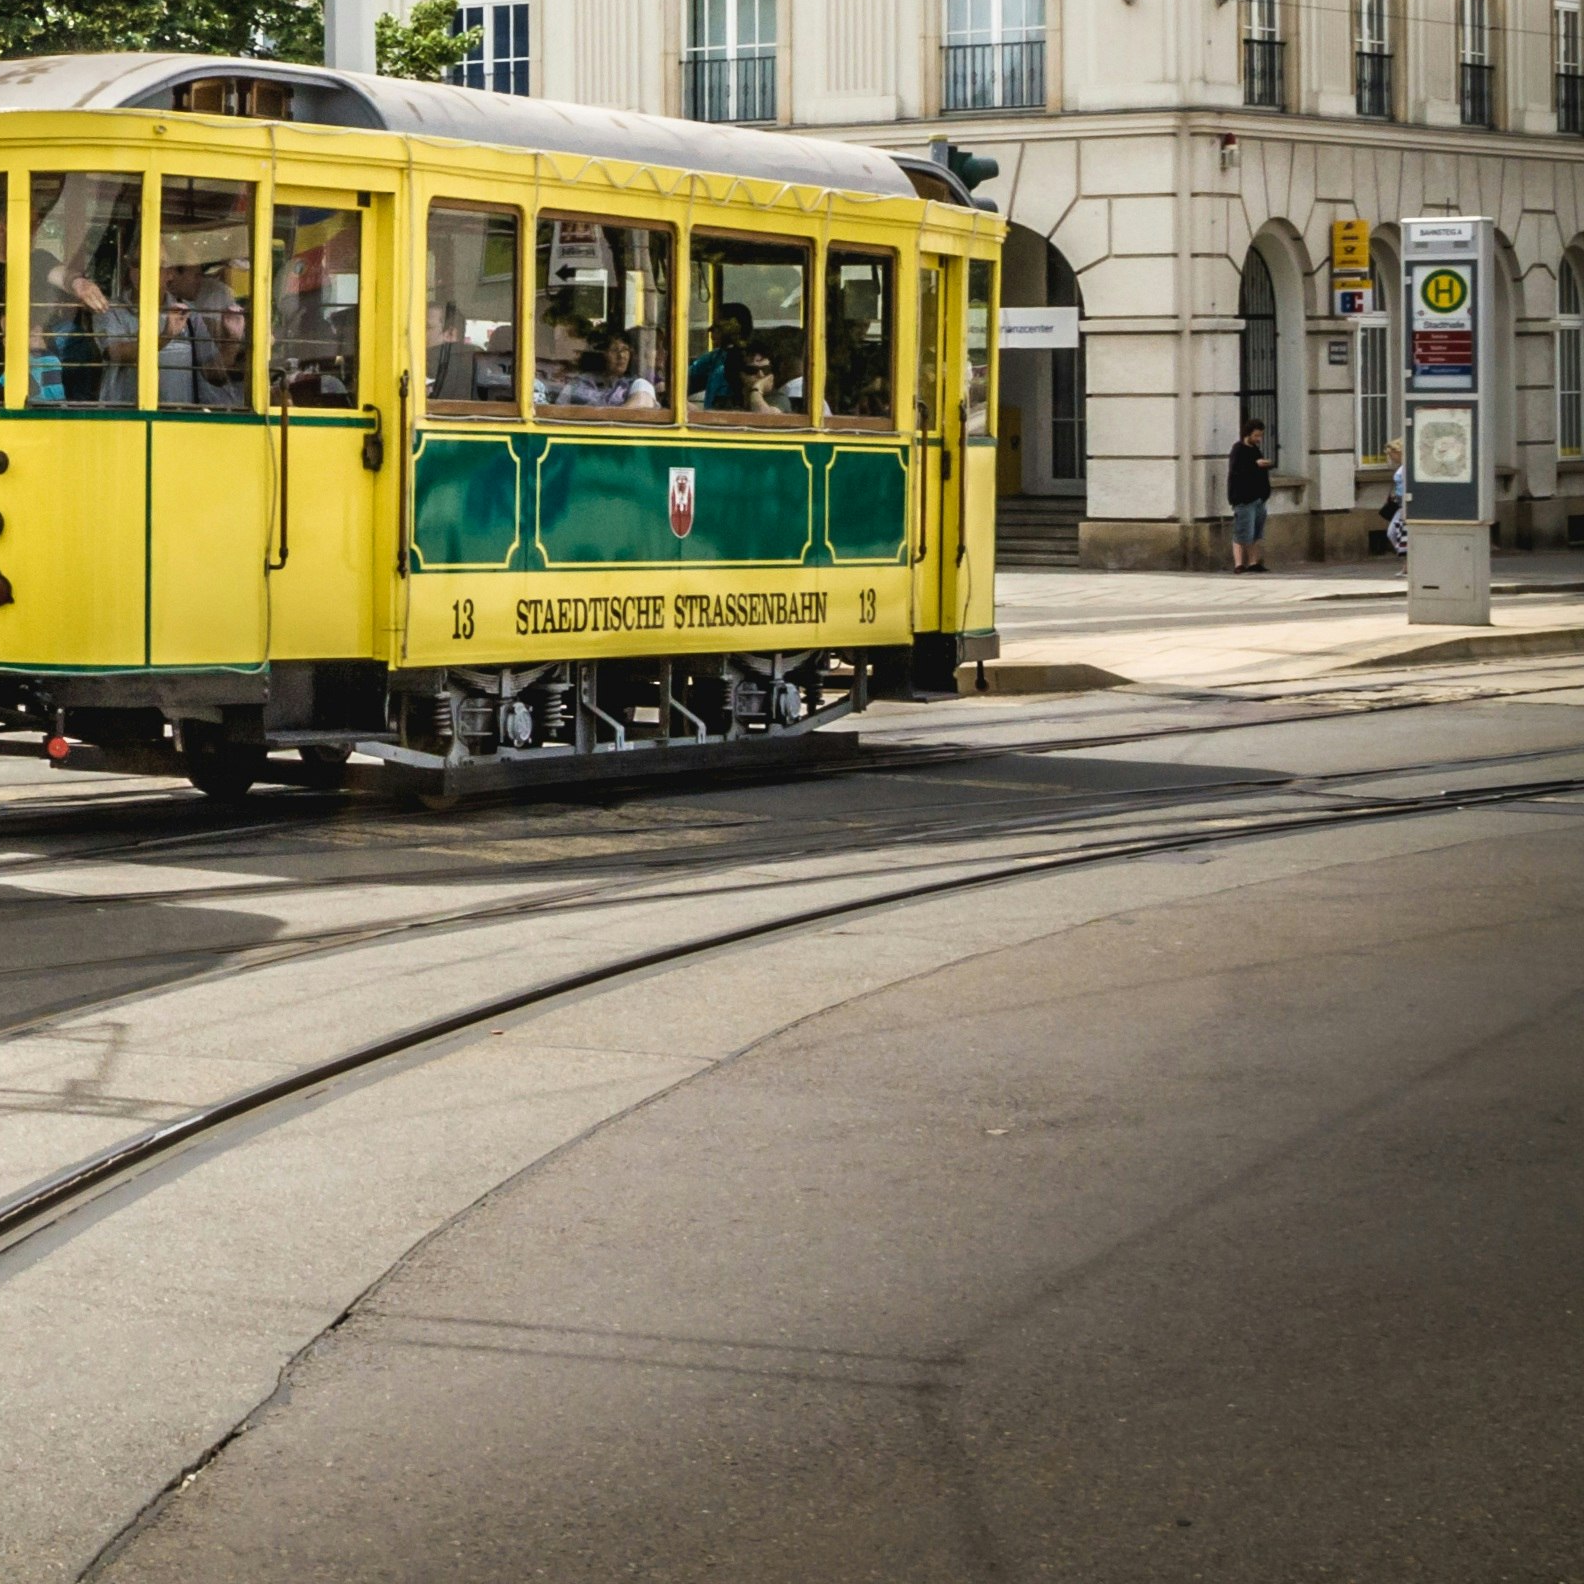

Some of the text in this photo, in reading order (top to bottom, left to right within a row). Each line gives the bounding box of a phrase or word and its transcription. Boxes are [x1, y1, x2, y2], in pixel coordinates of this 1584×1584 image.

[1435, 278, 1454, 304] H
[452, 588, 876, 639] 13 STAEDTISCHE STRASSENBAHN 13
